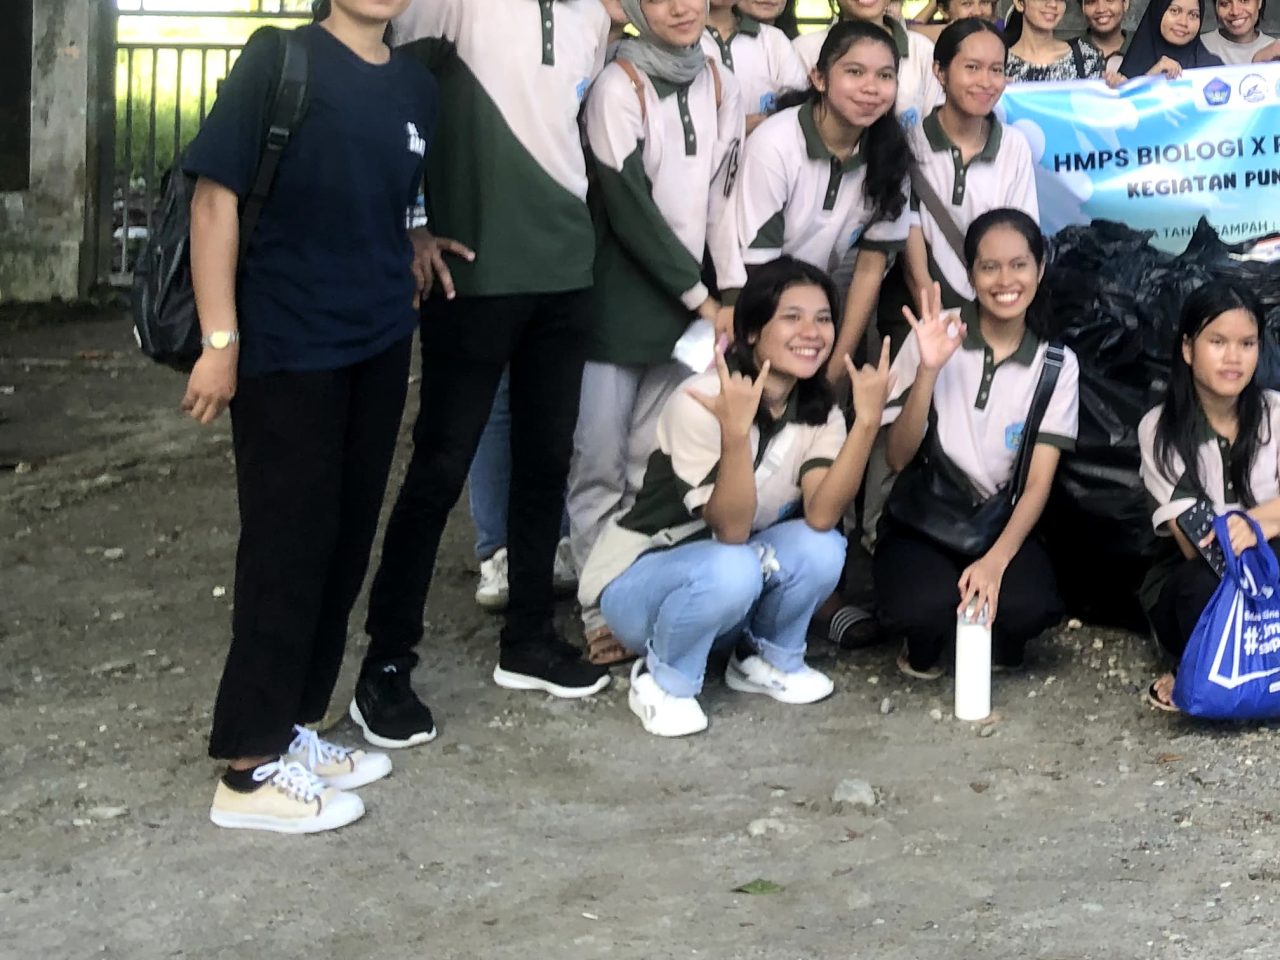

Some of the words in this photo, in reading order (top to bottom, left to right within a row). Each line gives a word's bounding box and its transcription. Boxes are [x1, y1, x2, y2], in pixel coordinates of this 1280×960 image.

[1054, 148, 1129, 173] HMPS
[1137, 138, 1244, 166] BIOLOGI
[1251, 136, 1267, 157] X
[1127, 172, 1237, 199] KEGIATAN
